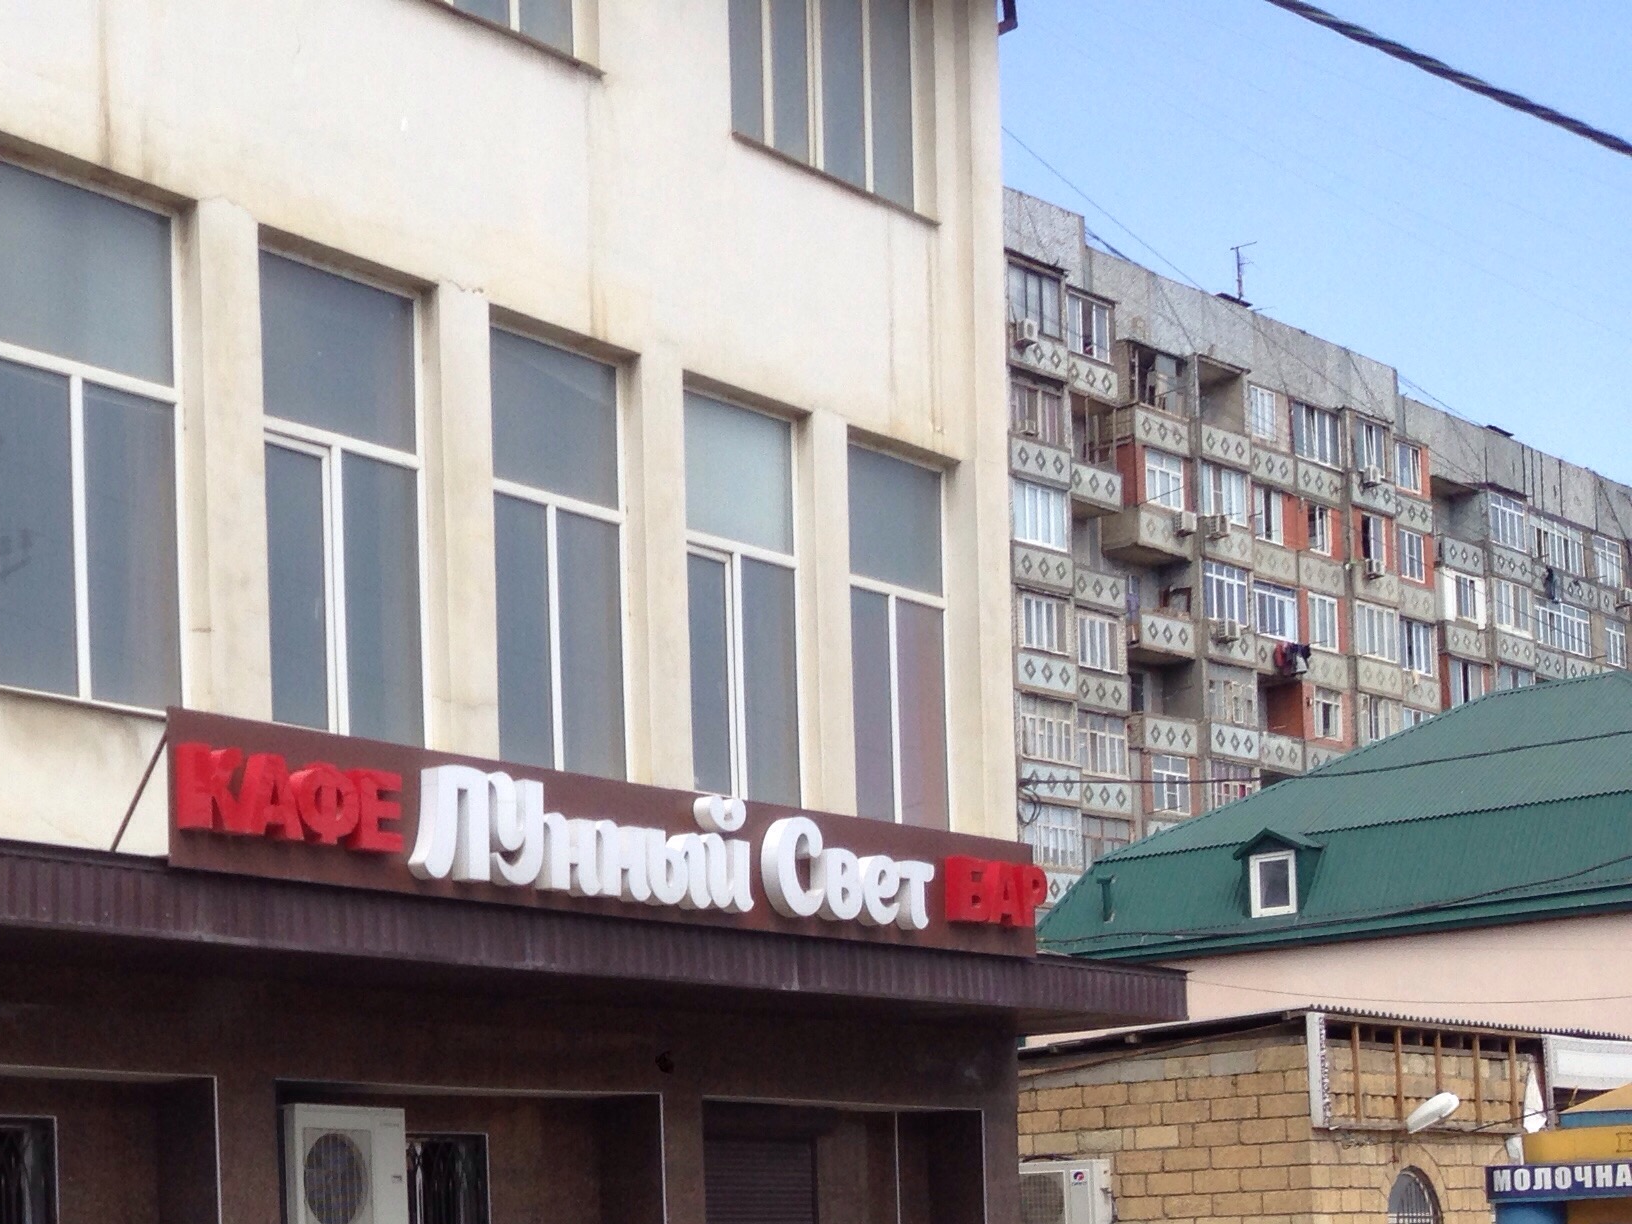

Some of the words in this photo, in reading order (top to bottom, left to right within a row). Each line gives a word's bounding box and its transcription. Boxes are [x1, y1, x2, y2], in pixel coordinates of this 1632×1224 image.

[176, 742, 404, 853] КАФЕ
[760, 816, 935, 930] Свет
[944, 855, 1048, 927] БАР
[1493, 1164, 1632, 1192] МОЛОЧНА
